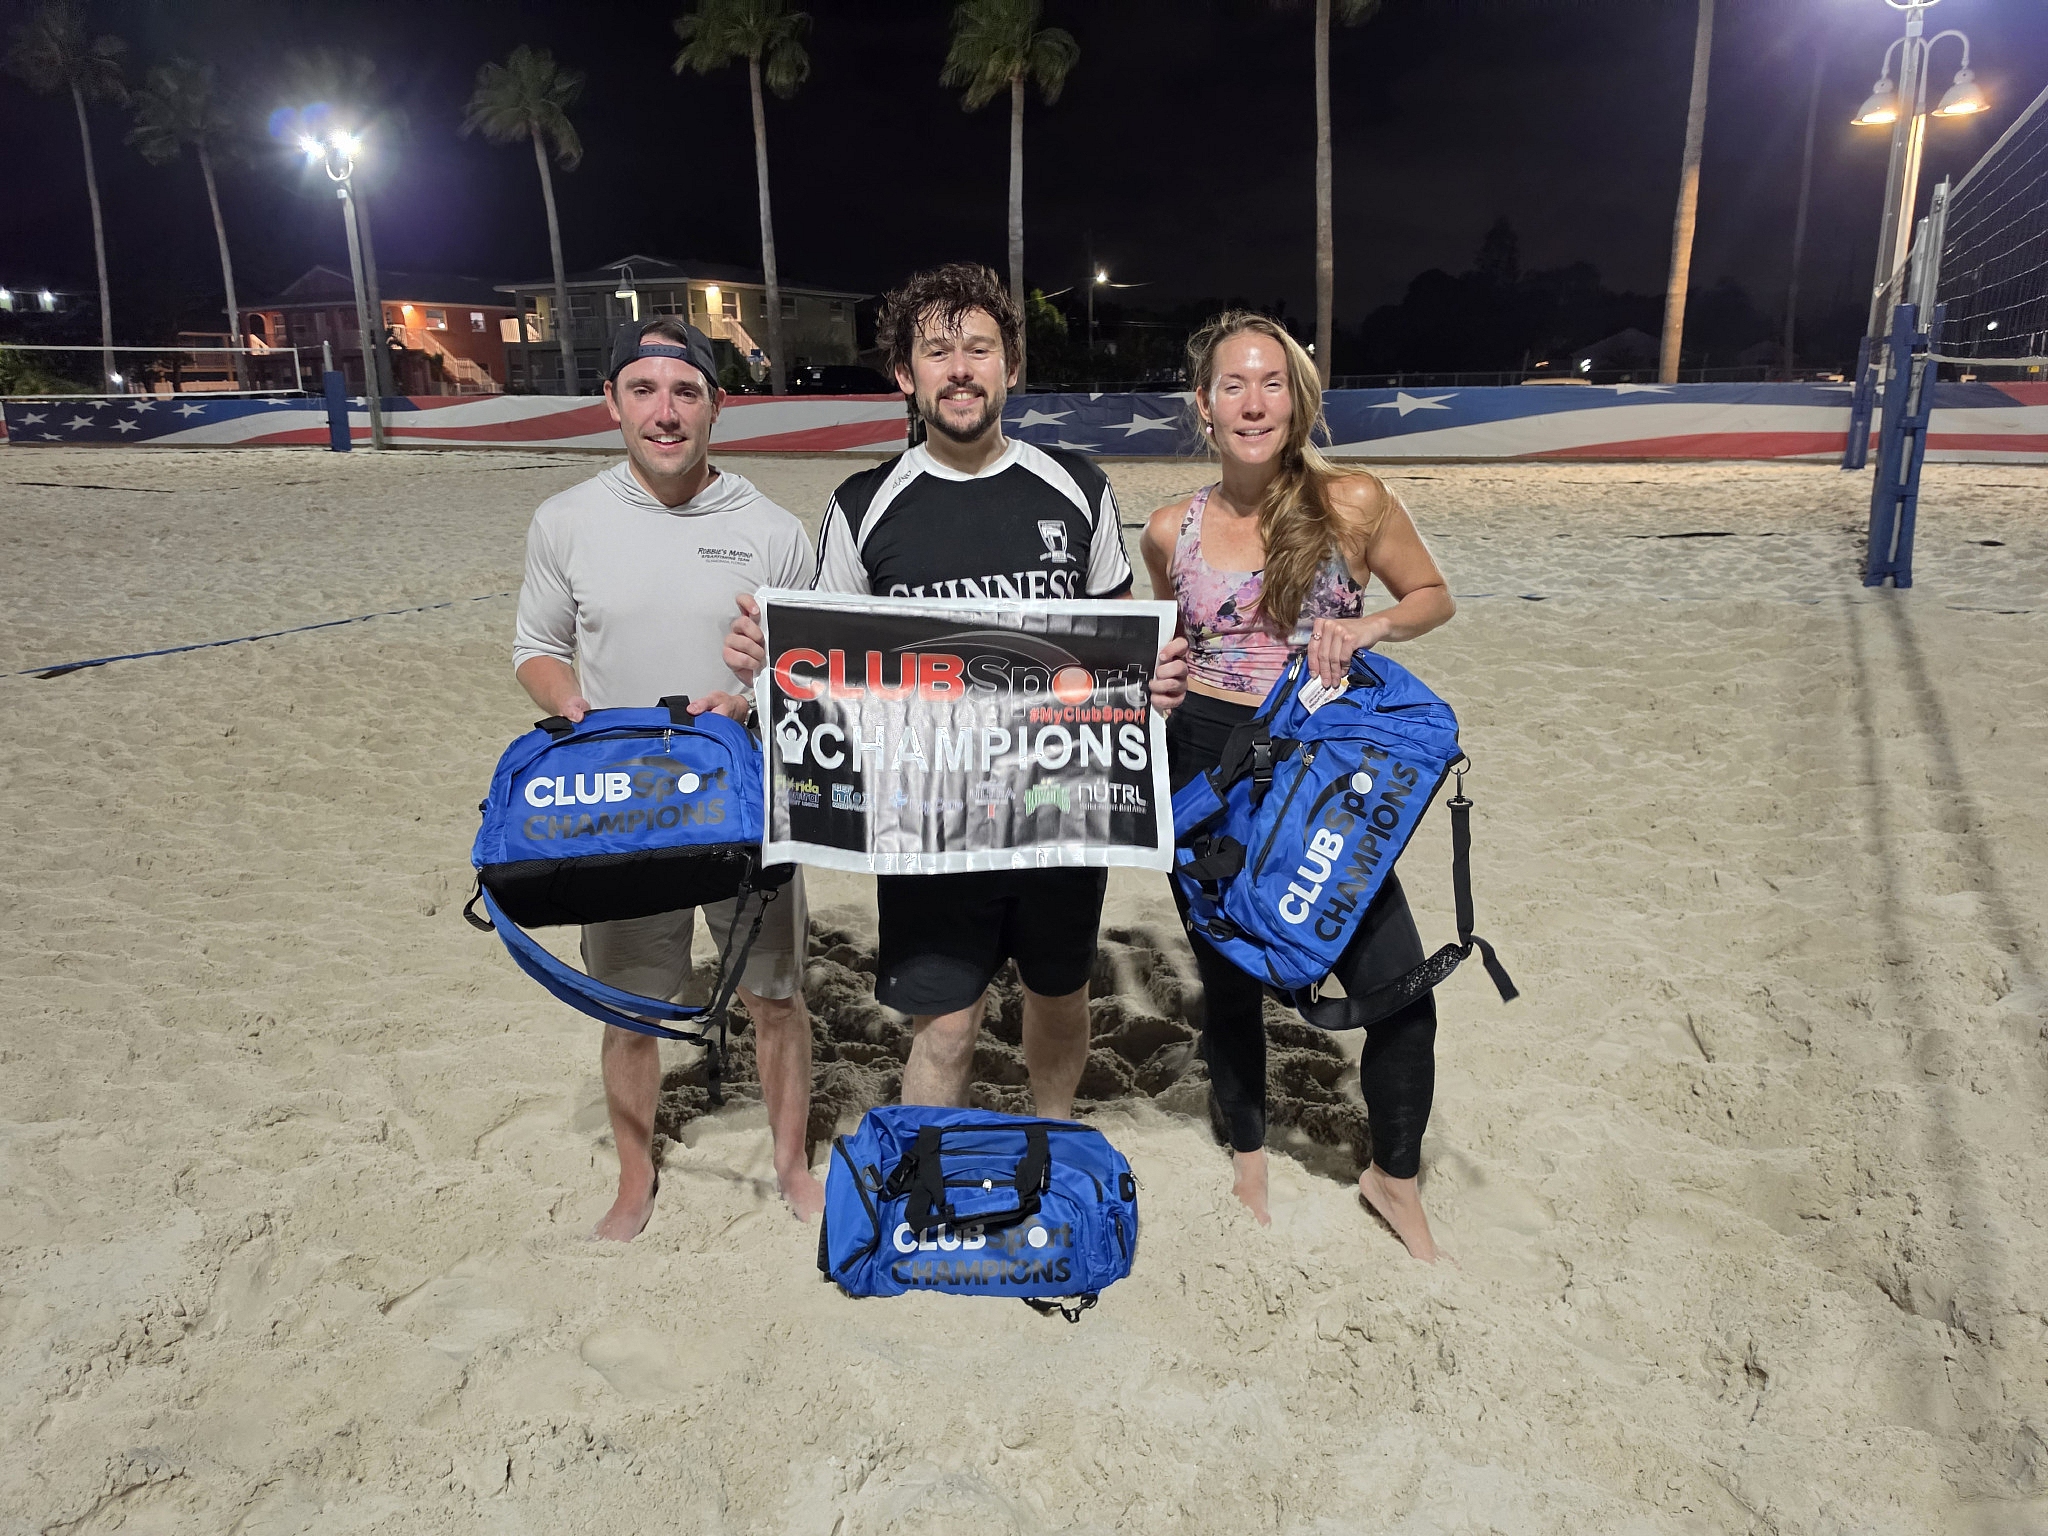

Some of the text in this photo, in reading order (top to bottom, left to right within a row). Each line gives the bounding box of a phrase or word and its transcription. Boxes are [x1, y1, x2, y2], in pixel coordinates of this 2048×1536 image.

[1029, 705, 1146, 726] #MyClubSport
[810, 721, 1148, 773] CHAMPIONS
[523, 798, 726, 841] CHAMPIONS
[1314, 761, 1419, 942] CHAMPIONS
[891, 1257, 1071, 1286] CHAMPIONS
